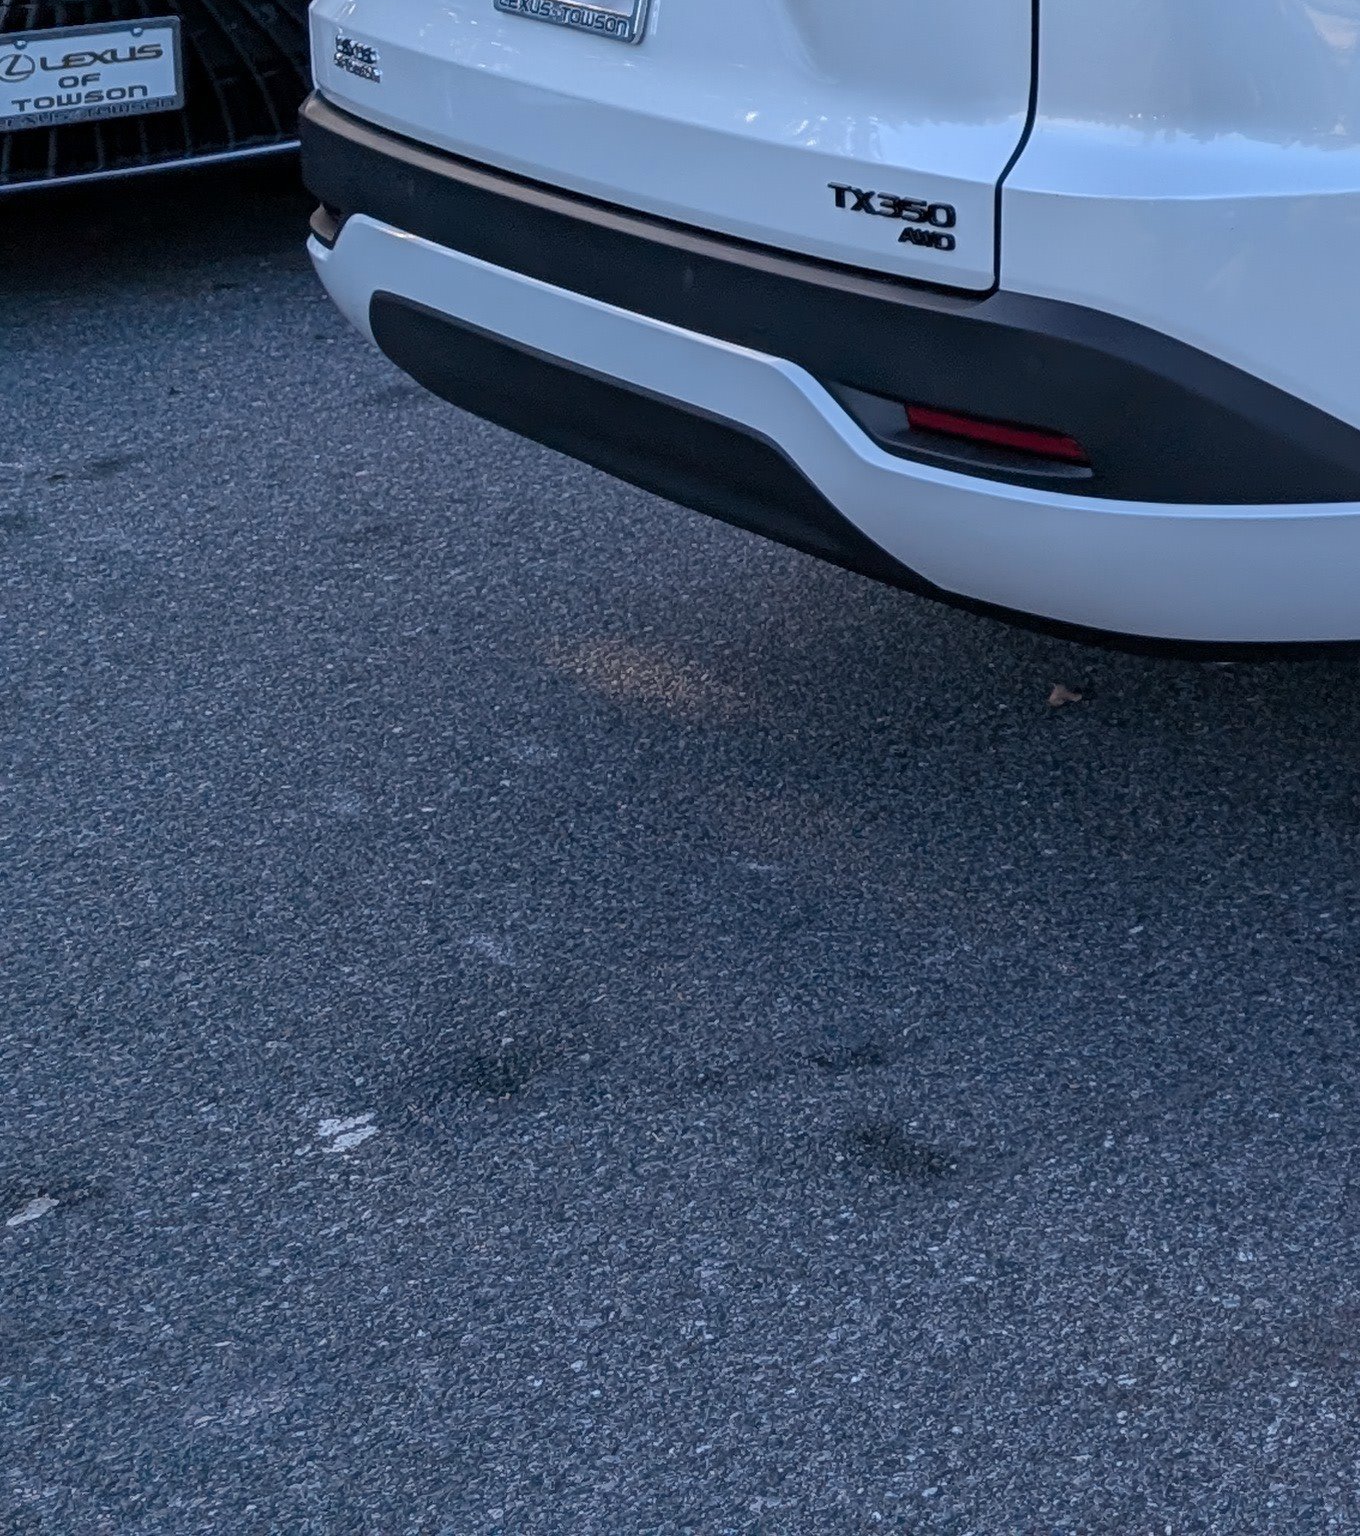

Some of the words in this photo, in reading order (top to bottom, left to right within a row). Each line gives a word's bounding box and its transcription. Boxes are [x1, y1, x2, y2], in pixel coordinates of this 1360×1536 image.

[560, 5, 630, 38] TOWSON
[40, 44, 163, 71] LEXUS
[58, 73, 101, 89] OF
[11, 85, 148, 113] TOWSON
[827, 181, 957, 228] TX350
[898, 226, 956, 251] AWD
